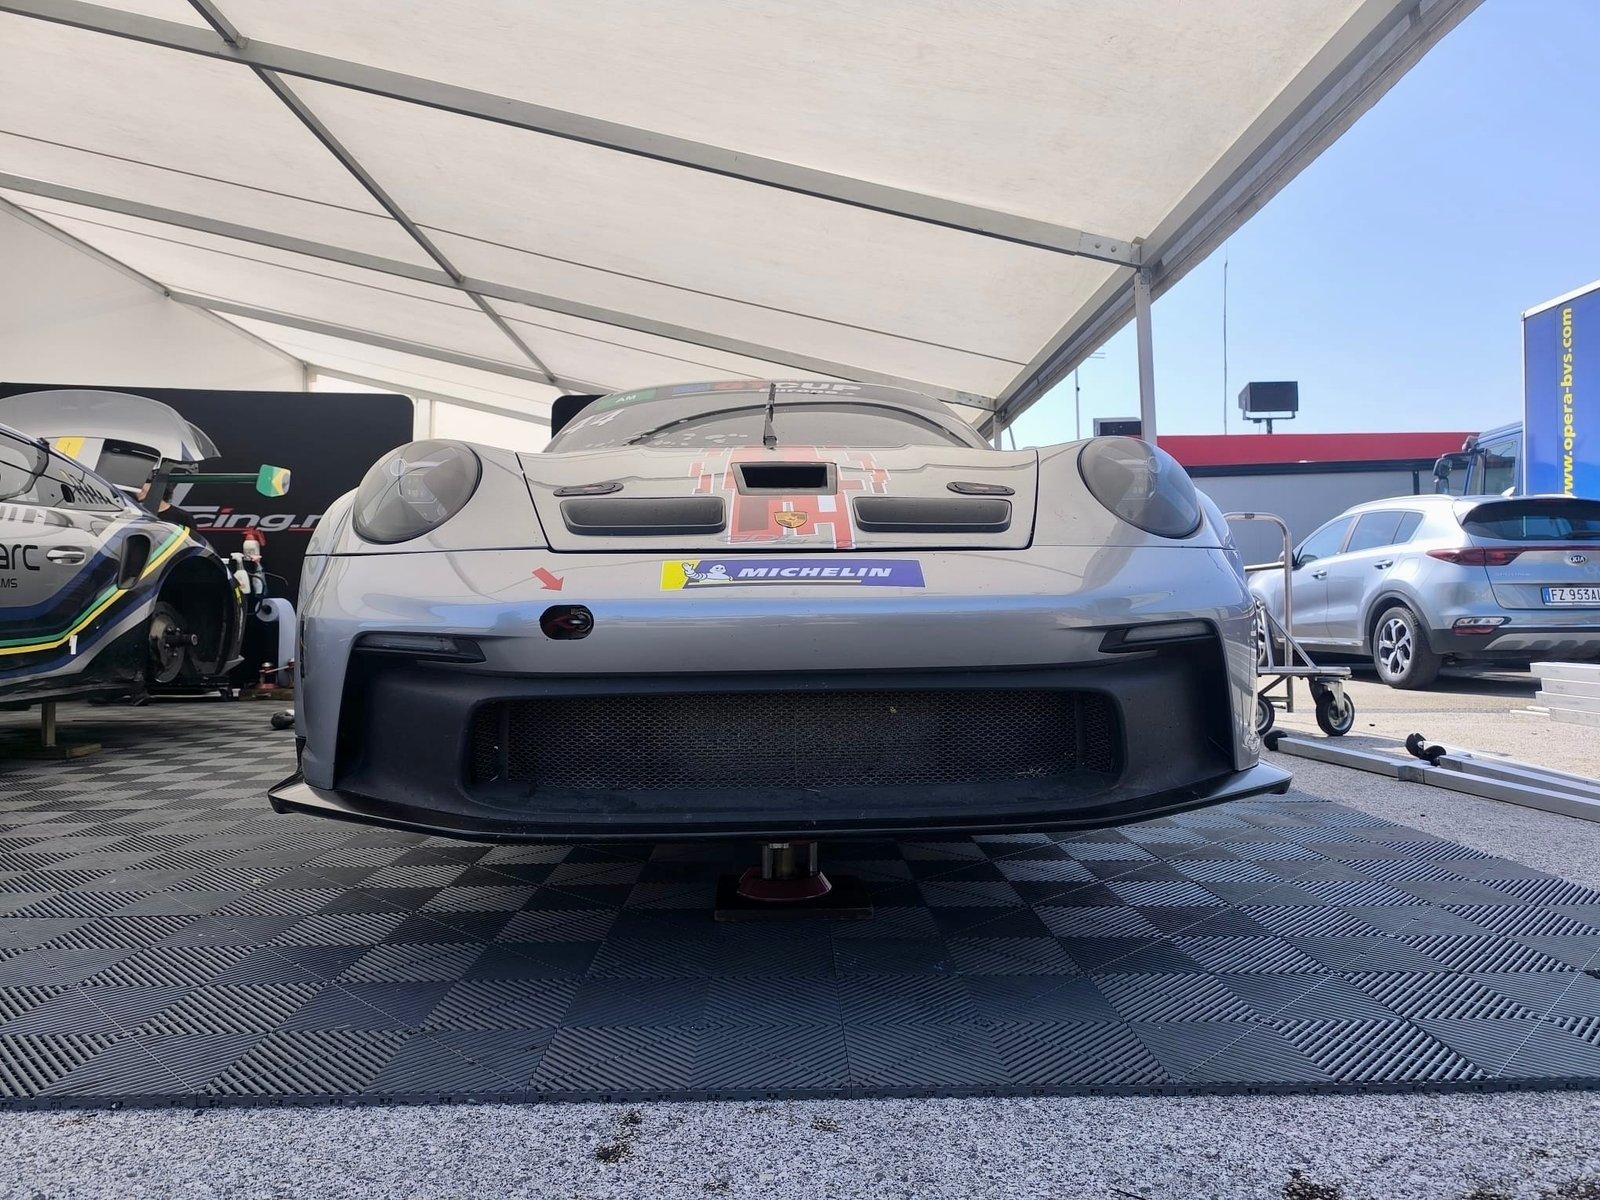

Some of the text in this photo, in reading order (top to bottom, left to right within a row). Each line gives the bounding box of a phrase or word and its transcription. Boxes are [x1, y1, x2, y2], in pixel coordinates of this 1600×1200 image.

[775, 382, 862, 391] CUP
[615, 393, 636, 404] AM
[737, 567, 893, 577] MICHELIN
[0, 578, 18, 588] MS
[1551, 589, 1566, 600] FZ
